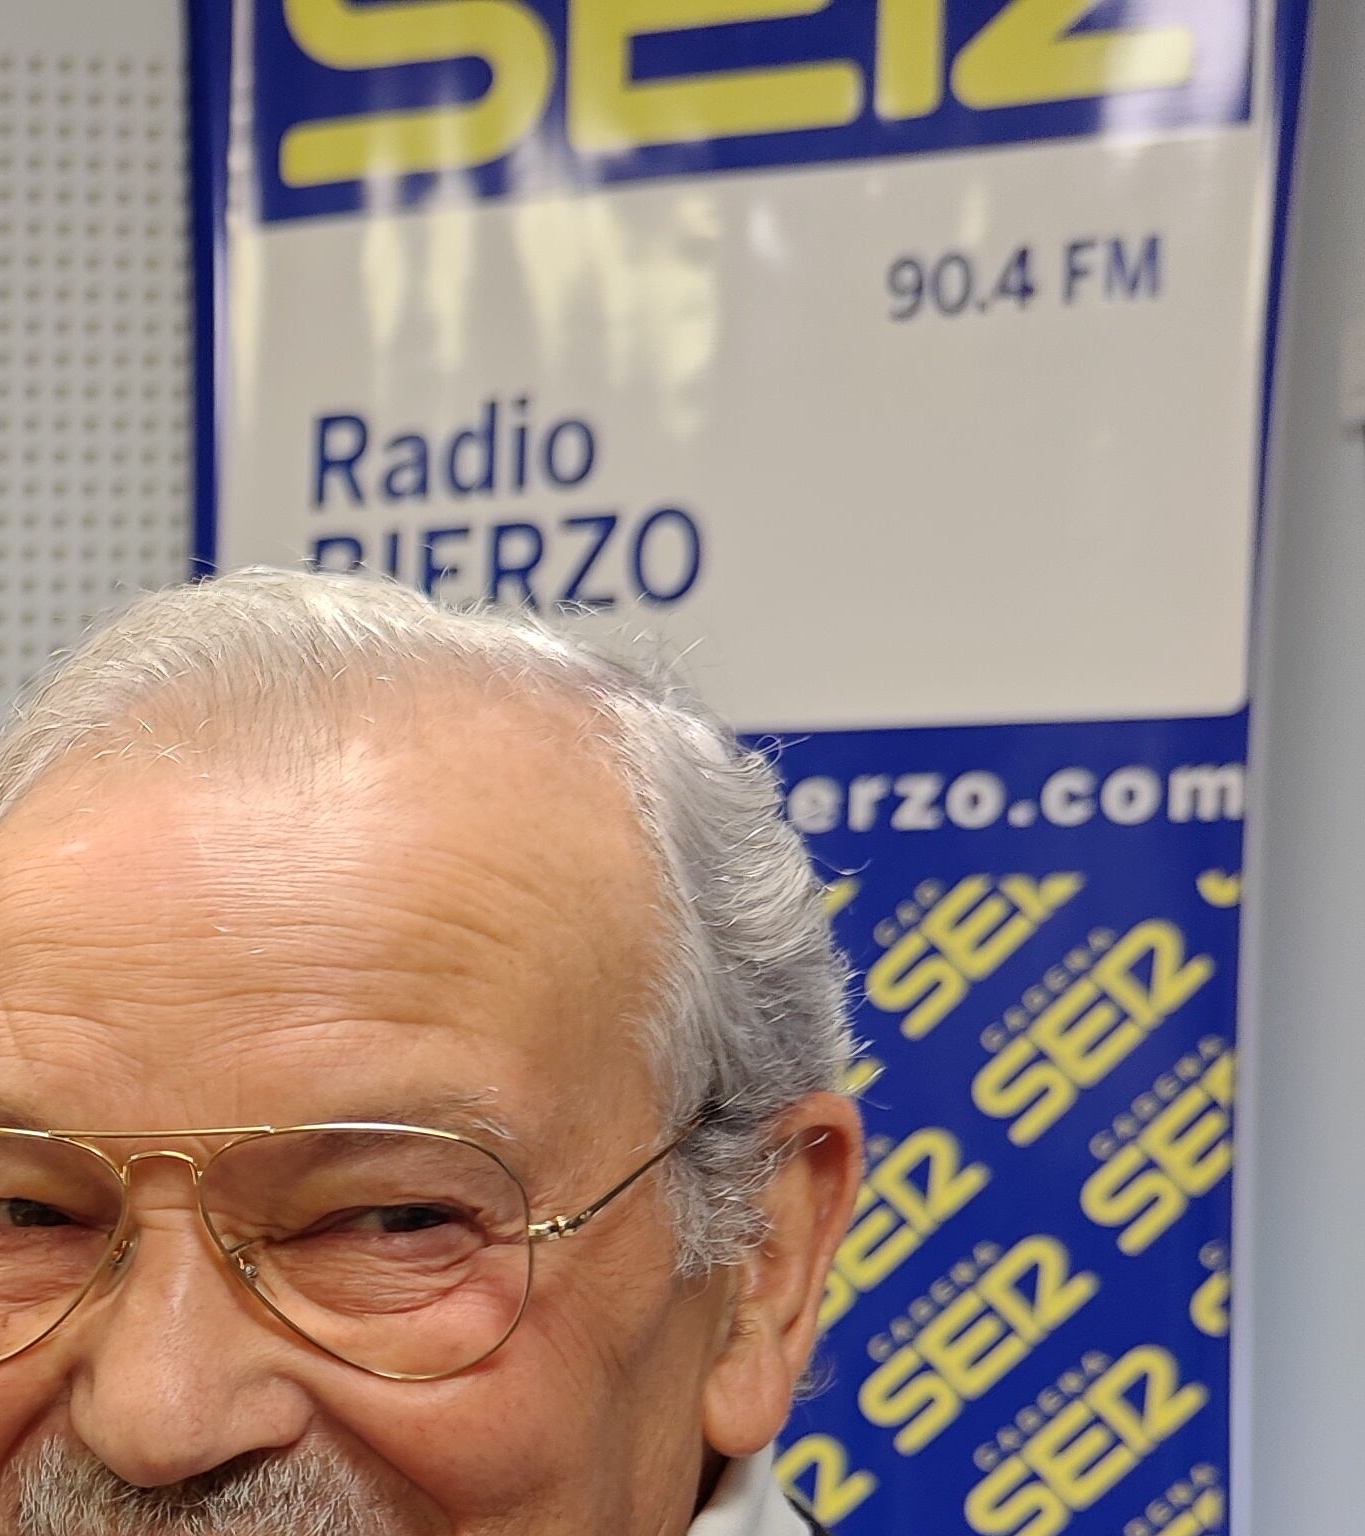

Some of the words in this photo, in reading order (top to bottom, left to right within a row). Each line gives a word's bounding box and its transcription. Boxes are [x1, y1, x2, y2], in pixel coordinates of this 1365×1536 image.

[886, 246, 1035, 322] 90.4
[1063, 234, 1161, 307] FM
[310, 398, 597, 510] Radio
[786, 762, 1245, 834] erzo.com
[972, 918, 1216, 1148] SER
[817, 1126, 992, 1340] ER
[1081, 1050, 1235, 1256] SE
[857, 1233, 1100, 1456] SER
